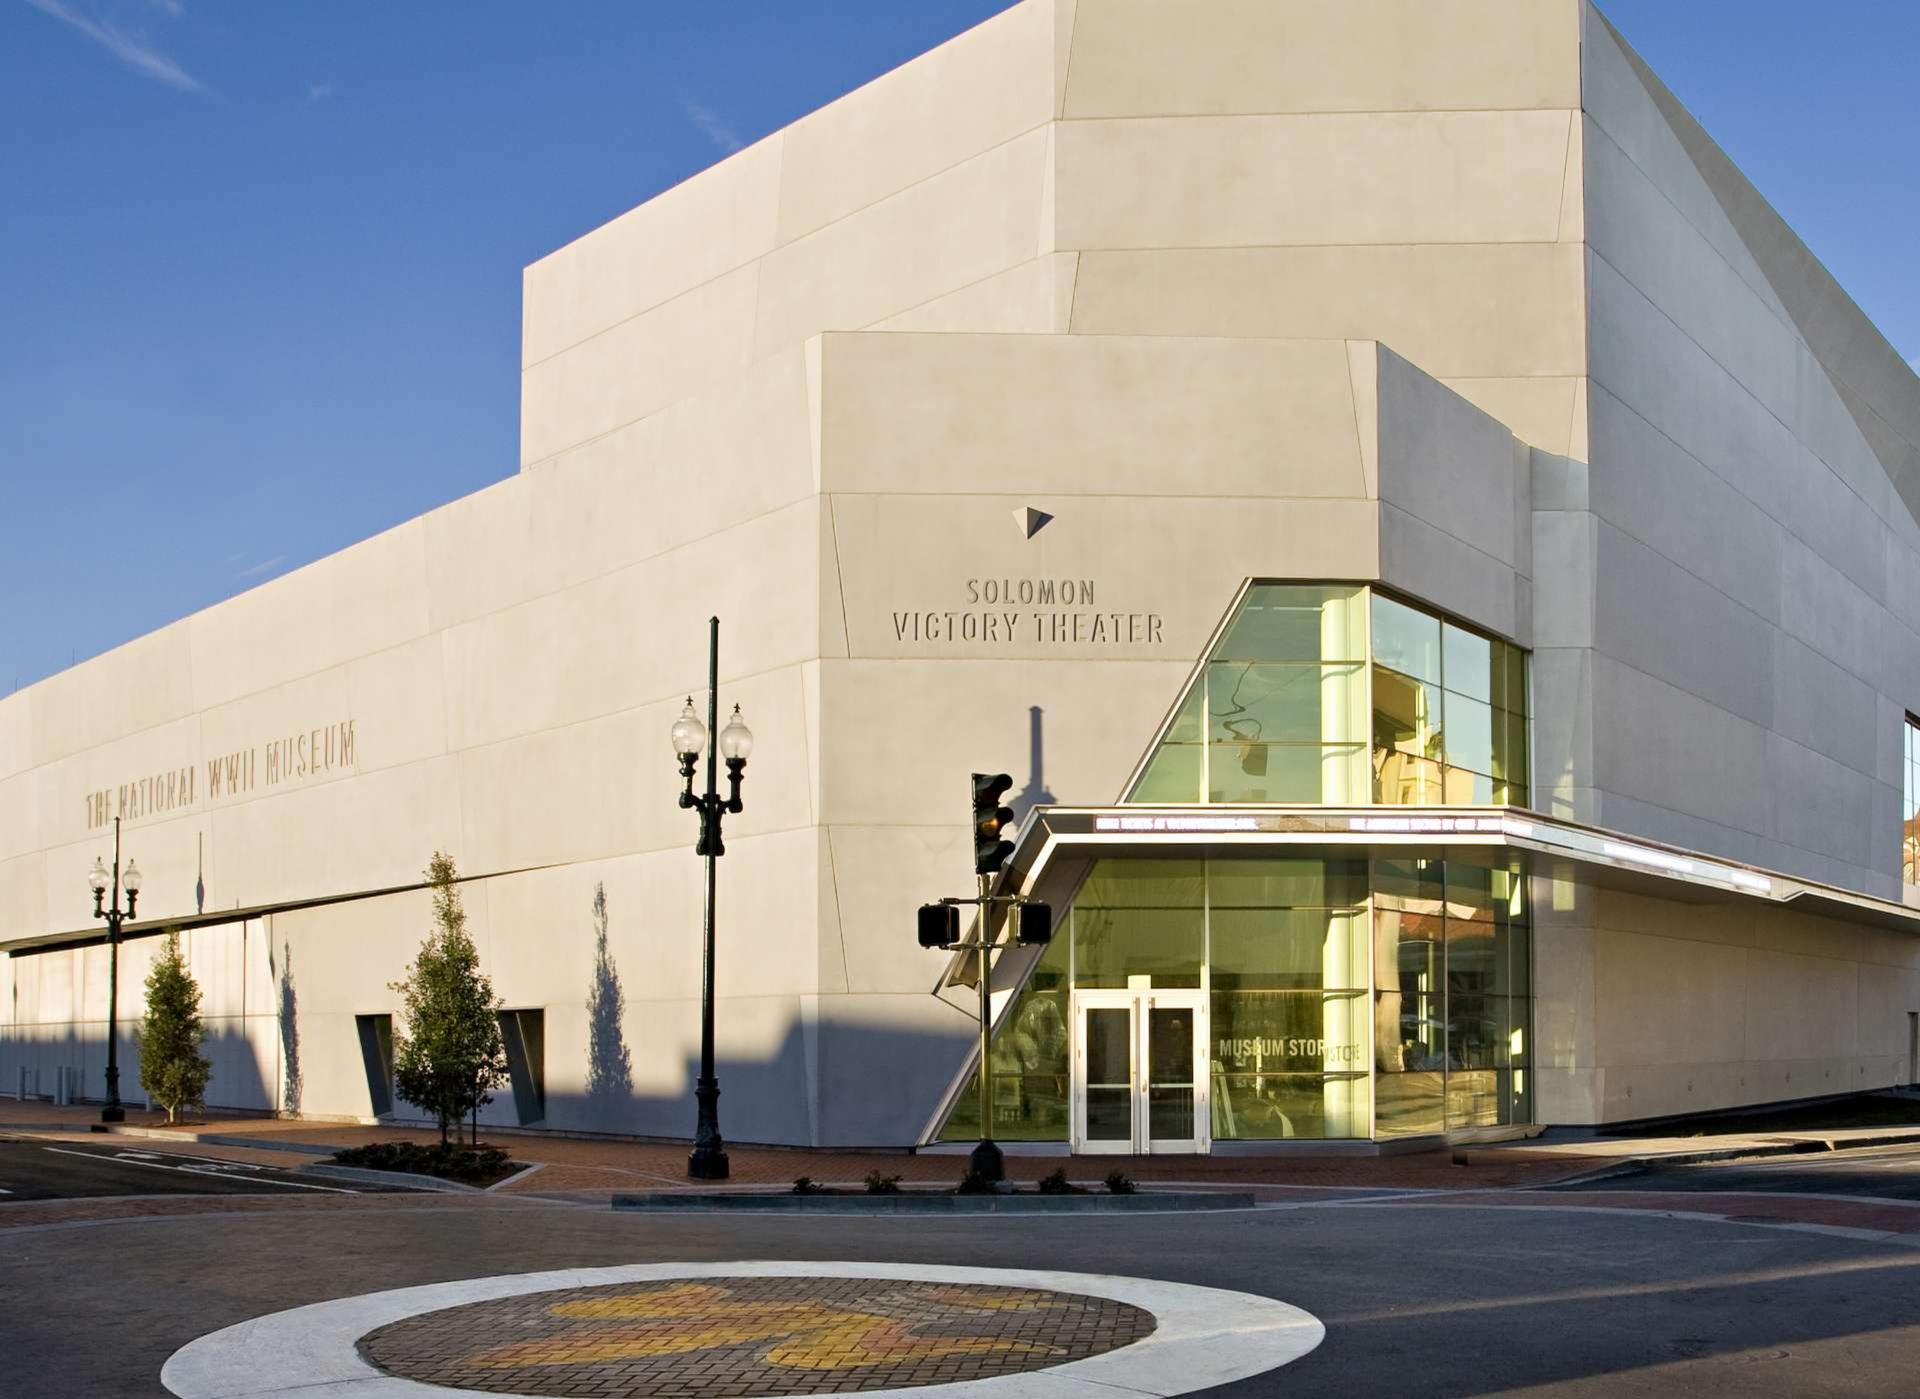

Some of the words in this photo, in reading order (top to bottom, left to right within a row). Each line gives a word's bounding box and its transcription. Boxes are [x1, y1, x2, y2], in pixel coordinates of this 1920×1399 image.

[966, 578, 1094, 605] SOLOMON
[893, 612, 1020, 642] VICTORY
[1033, 613, 1163, 643] THEATER
[86, 788, 113, 830] THE
[118, 766, 196, 821] NATIONAL
[208, 748, 256, 800] WWII
[266, 719, 356, 786] MUSEUM
